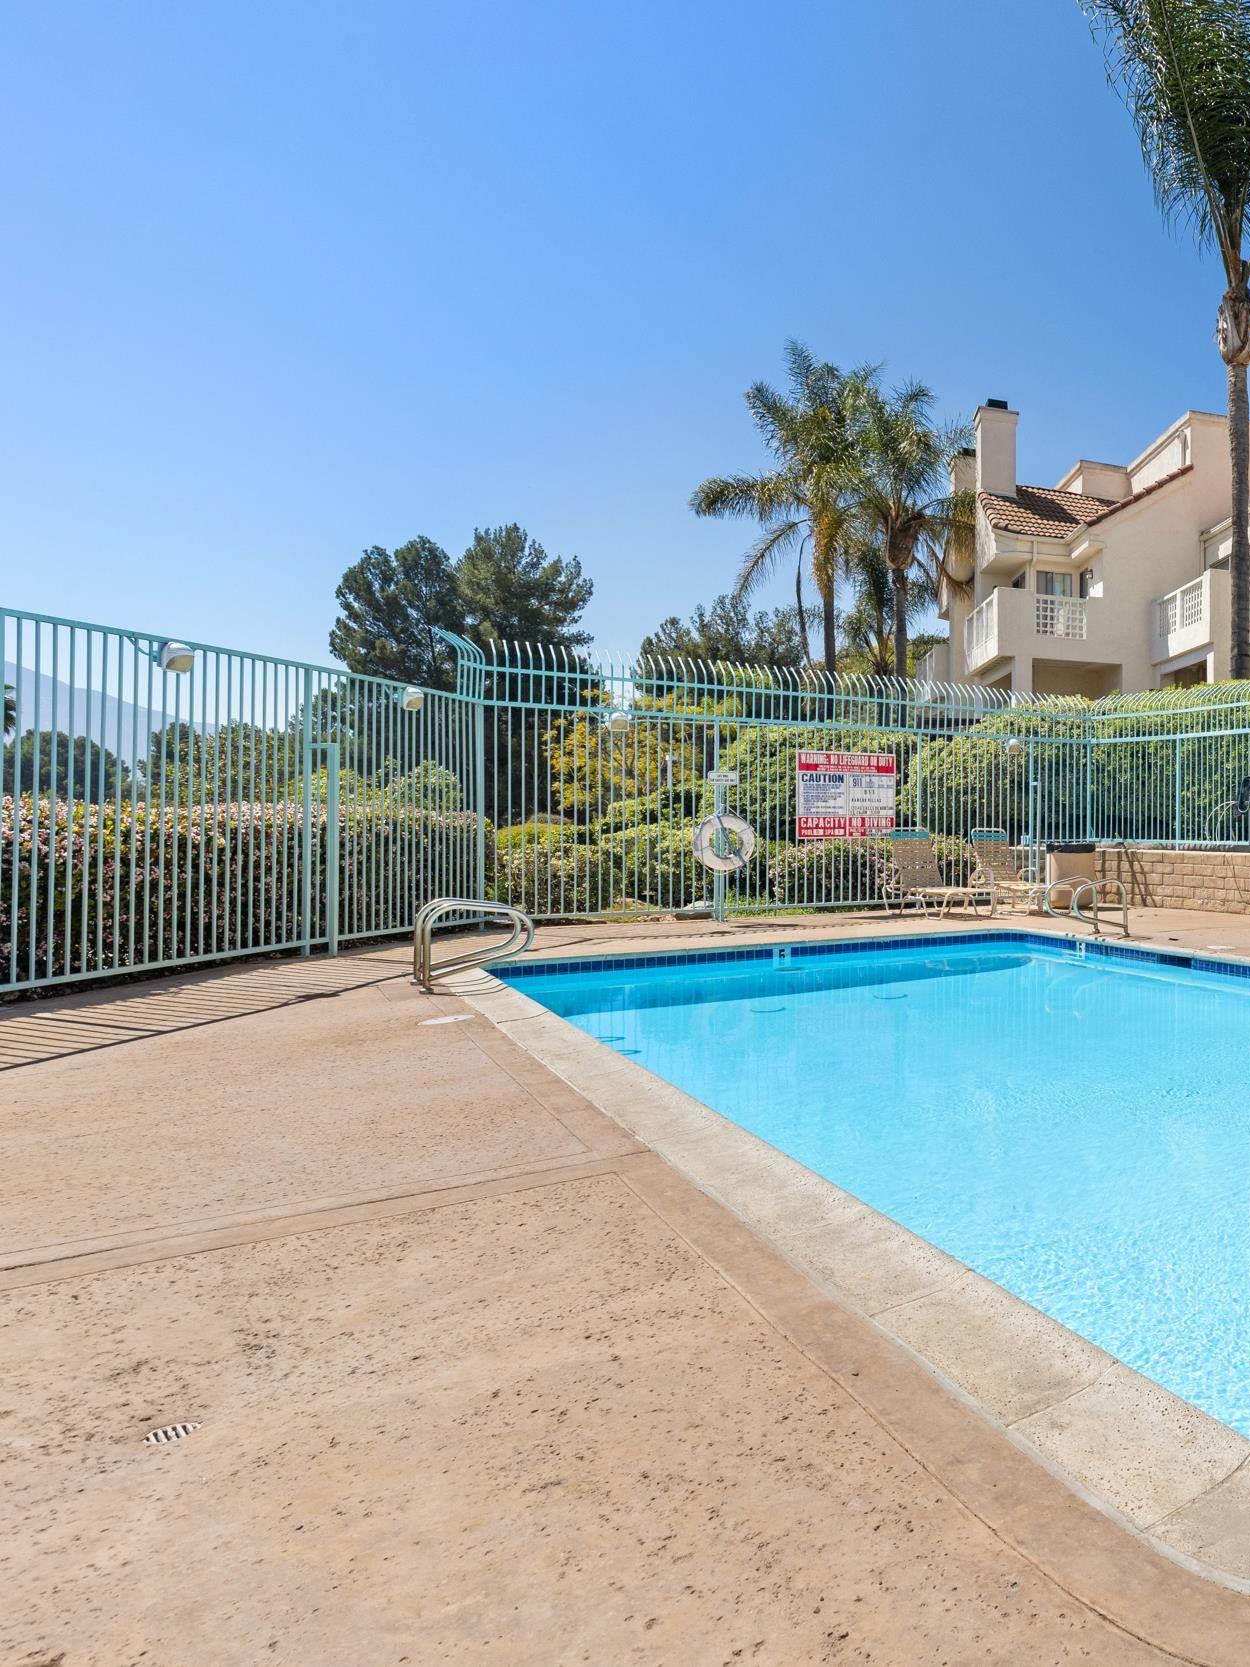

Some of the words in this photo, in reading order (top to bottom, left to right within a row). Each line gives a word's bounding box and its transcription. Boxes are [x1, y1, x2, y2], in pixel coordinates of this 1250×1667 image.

[801, 753, 829, 765] WARNING:
[830, 755, 838, 765] NO
[839, 755, 869, 766] LIFEGUARD
[870, 756, 878, 766] ON
[878, 756, 893, 766] DUTY
[801, 773, 844, 783] CAUTION
[852, 778, 862, 787] 911
[801, 817, 845, 828] CAPACITY
[852, 817, 862, 826] NO
[865, 817, 891, 827] DIVING
